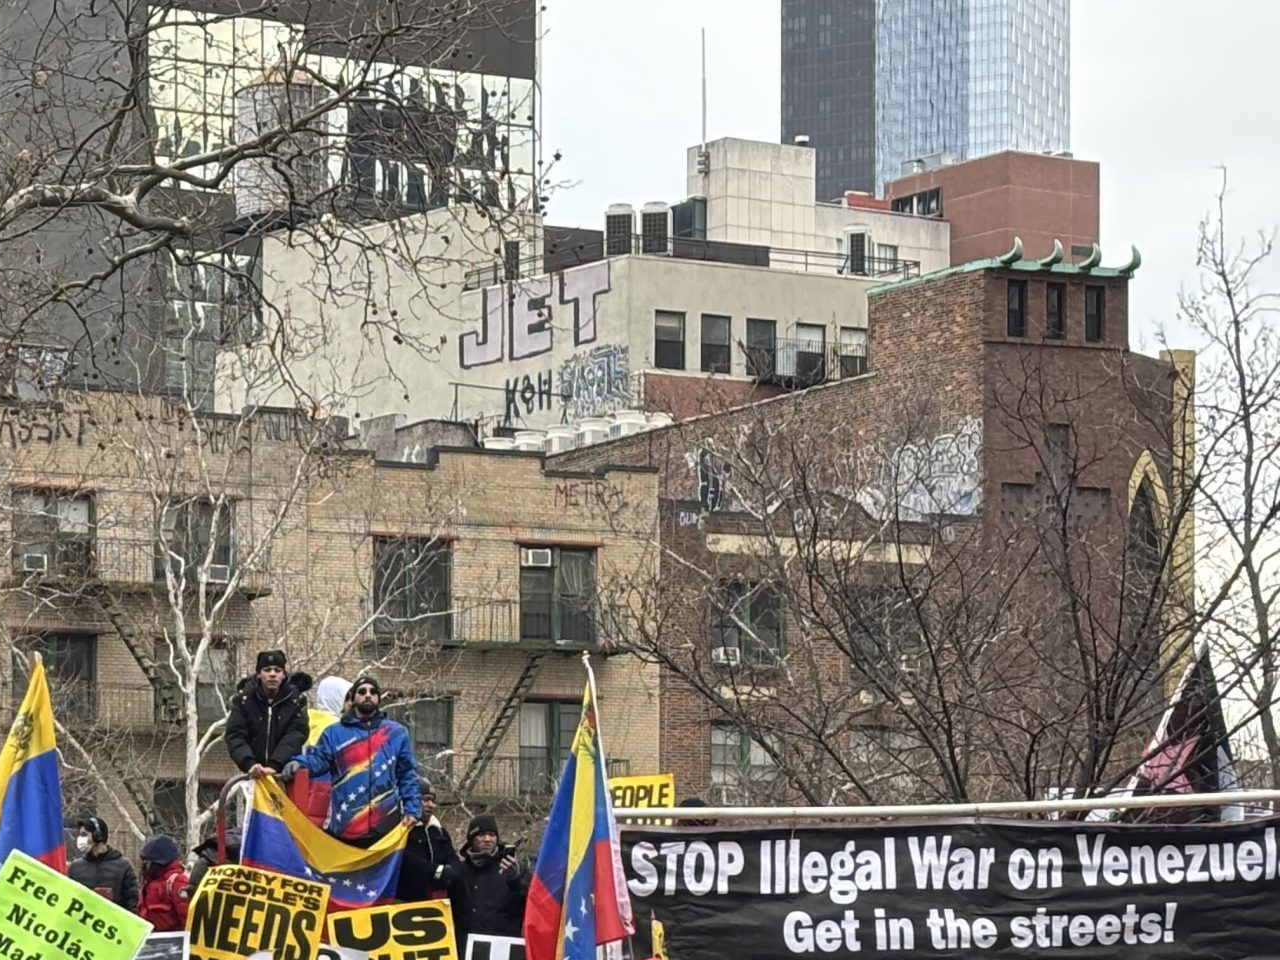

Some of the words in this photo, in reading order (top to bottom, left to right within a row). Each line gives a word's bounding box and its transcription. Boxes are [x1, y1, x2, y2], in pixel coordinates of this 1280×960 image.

[459, 260, 611, 369] JET
[208, 867, 277, 887] MONEY
[280, 878, 324, 898] FOR
[627, 840, 745, 897] STOP
[760, 837, 897, 904] Illegal
[908, 834, 995, 890] War
[1008, 847, 1063, 890] on
[1075, 827, 1280, 887] Venezuel
[7, 866, 59, 907] Free
[64, 897, 123, 946] Pres.
[203, 877, 321, 912] PEOPLE'S
[333, 907, 448, 951] US
[783, 909, 862, 954] Get
[874, 908, 915, 950] in
[926, 908, 998, 950] the
[1010, 902, 1178, 949] streets!
